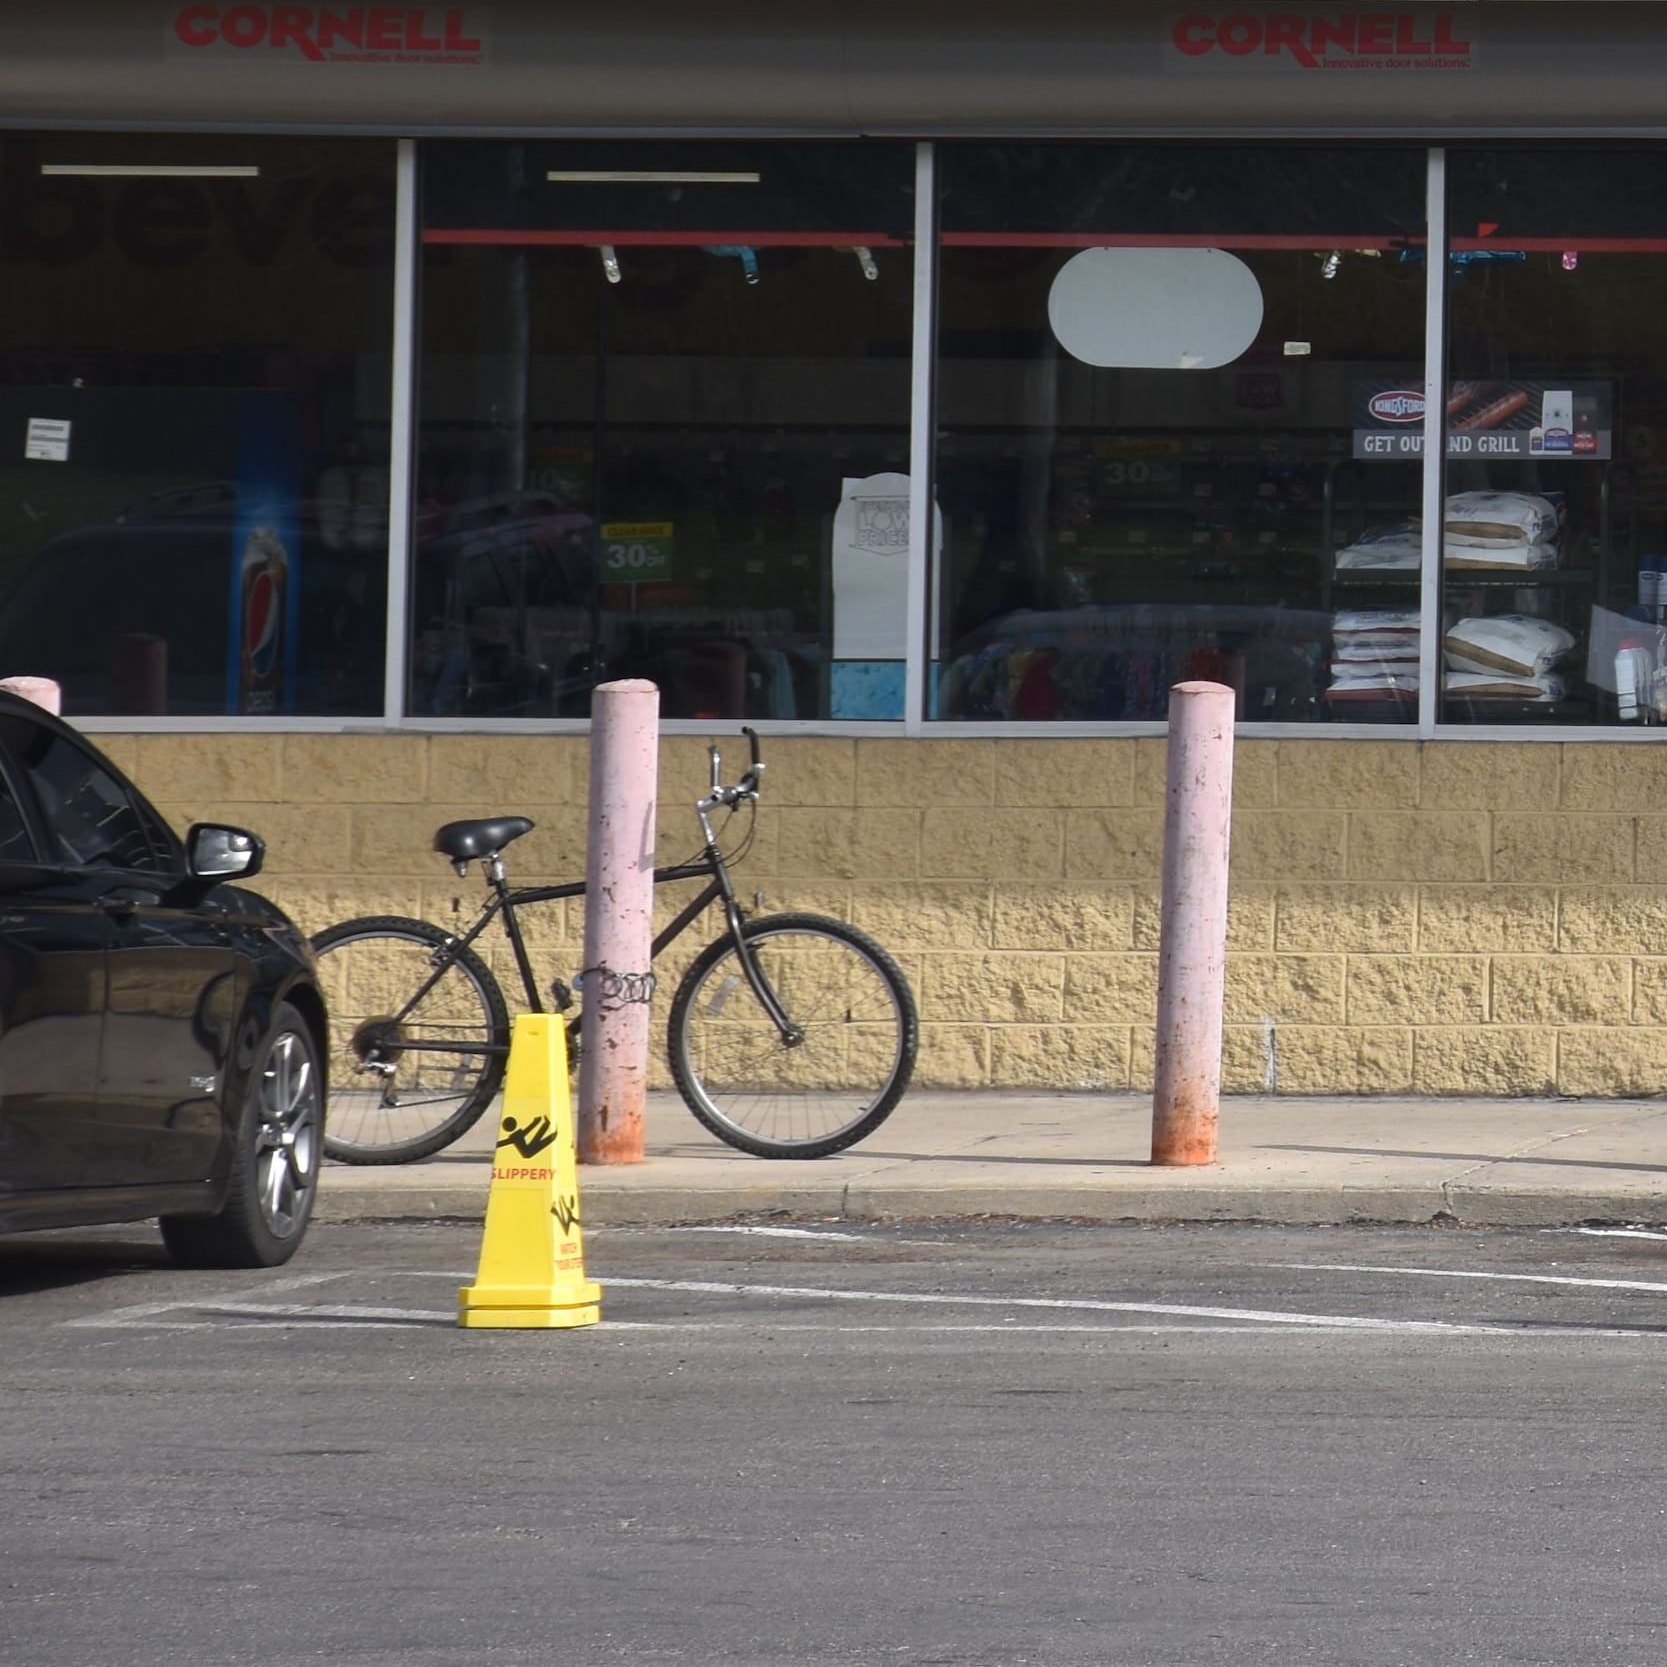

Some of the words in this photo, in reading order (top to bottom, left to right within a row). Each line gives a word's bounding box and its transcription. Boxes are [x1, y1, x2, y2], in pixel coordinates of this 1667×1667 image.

[174, 3, 481, 62] CORNELL
[1171, 12, 1470, 69] CORNELL
[1385, 57, 1412, 70] door
[1364, 435, 1396, 453] GET
[1447, 436, 1472, 453] ND
[1478, 436, 1520, 453] GRILL
[491, 1167, 557, 1181] SLIPPERY
